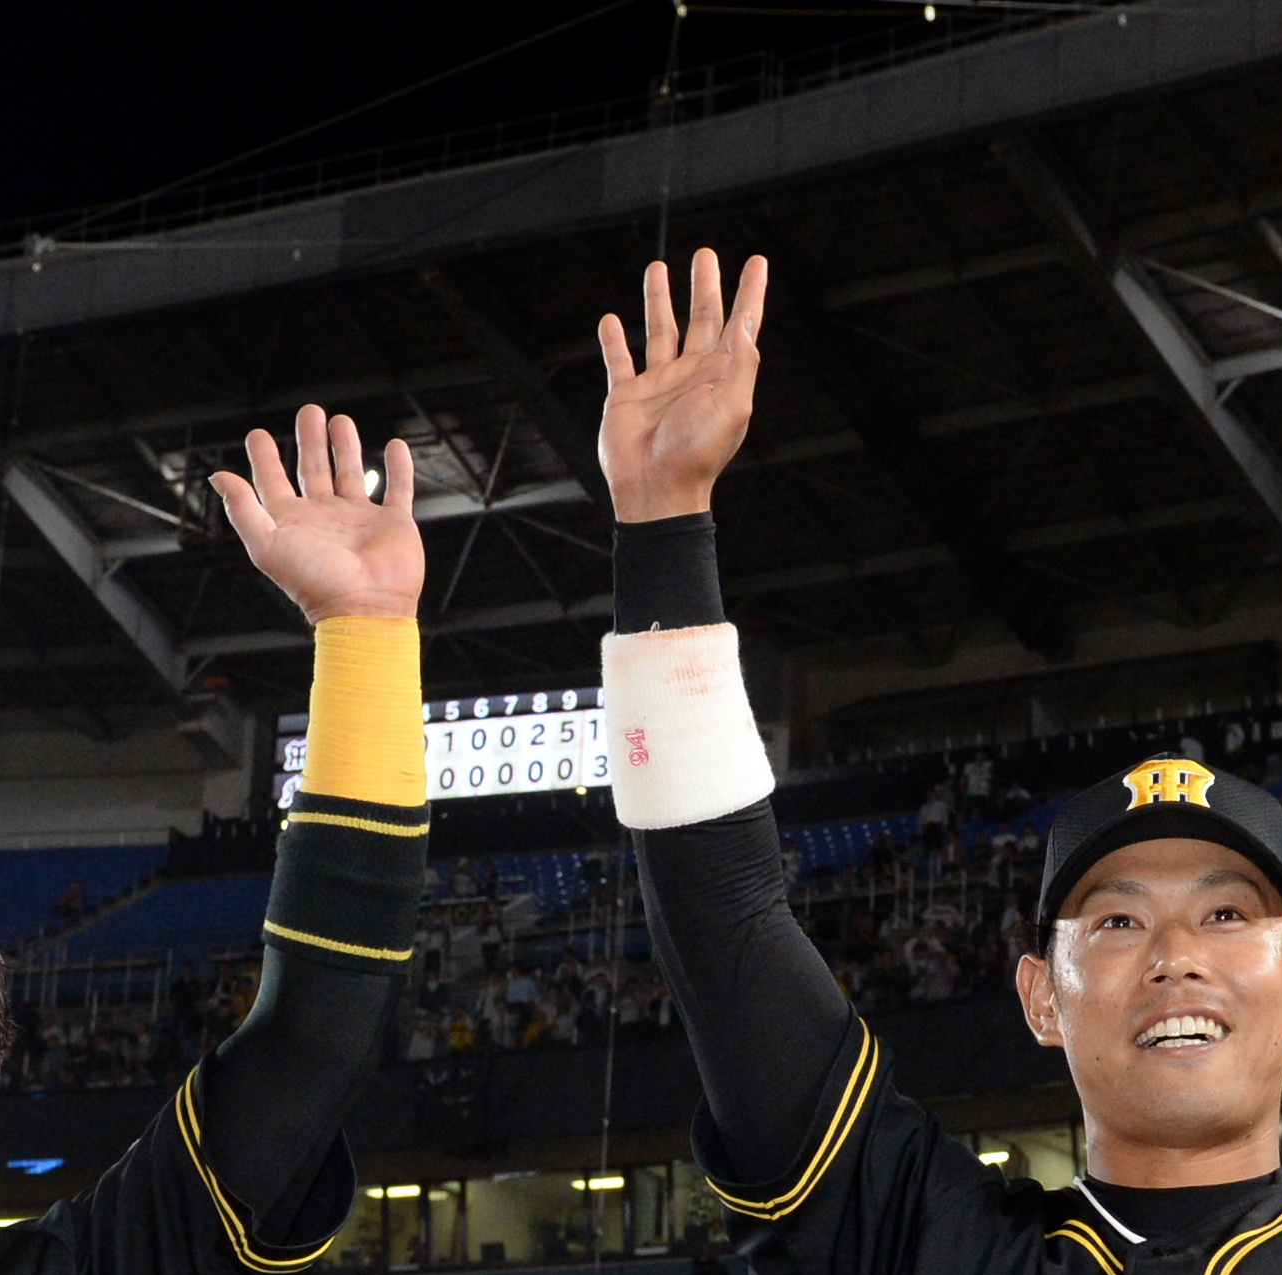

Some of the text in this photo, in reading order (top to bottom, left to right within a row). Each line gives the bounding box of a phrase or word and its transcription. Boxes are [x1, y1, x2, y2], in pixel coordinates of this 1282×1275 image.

[444, 690, 578, 720] 5 6 7 8 9
[445, 732, 454, 752] 1
[471, 728, 487, 750] 0
[501, 726, 516, 747] 0
[531, 724, 546, 745] 2
[560, 721, 575, 742] 5
[626, 728, 649, 766] 94
[439, 755, 609, 790] 0 0 0 0 0 3
